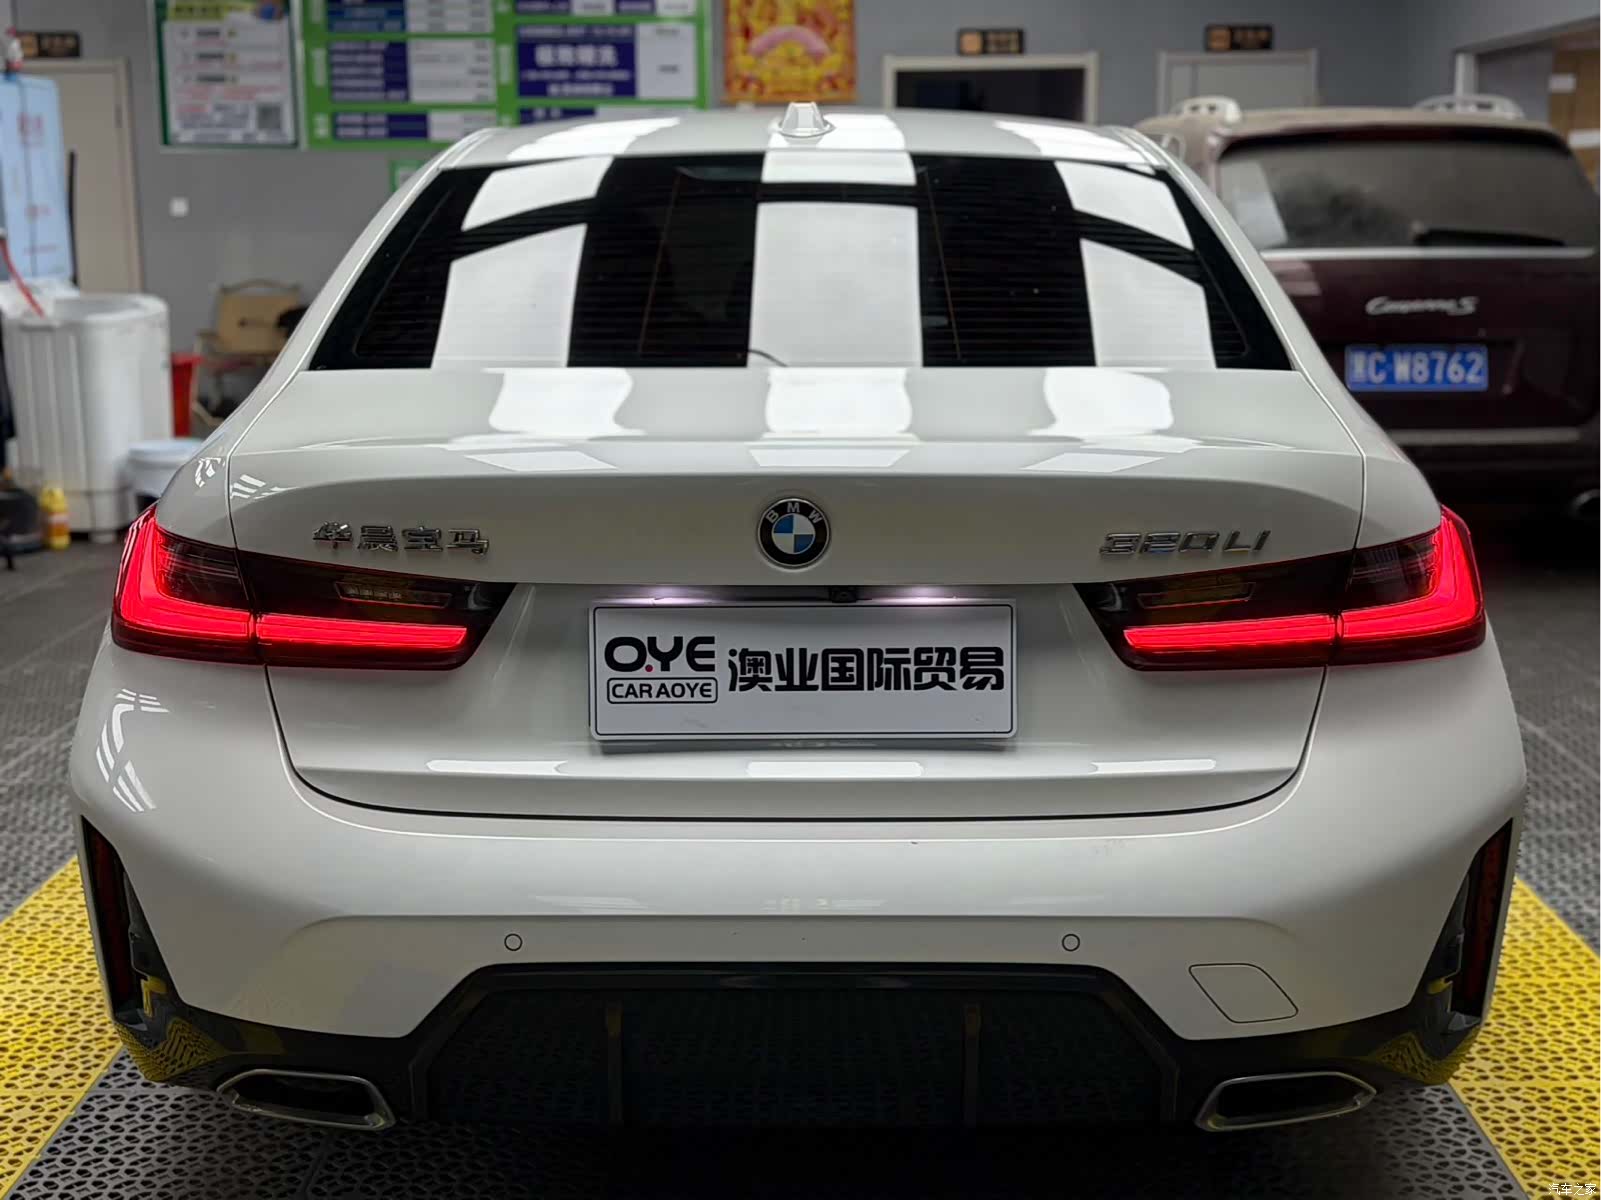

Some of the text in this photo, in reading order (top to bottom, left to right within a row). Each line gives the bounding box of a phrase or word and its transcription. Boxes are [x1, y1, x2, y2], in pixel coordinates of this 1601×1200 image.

[765, 502, 823, 524] BMW
[313, 521, 489, 555] 华晨宝马
[728, 647, 1004, 691] 澳业国际贸易
